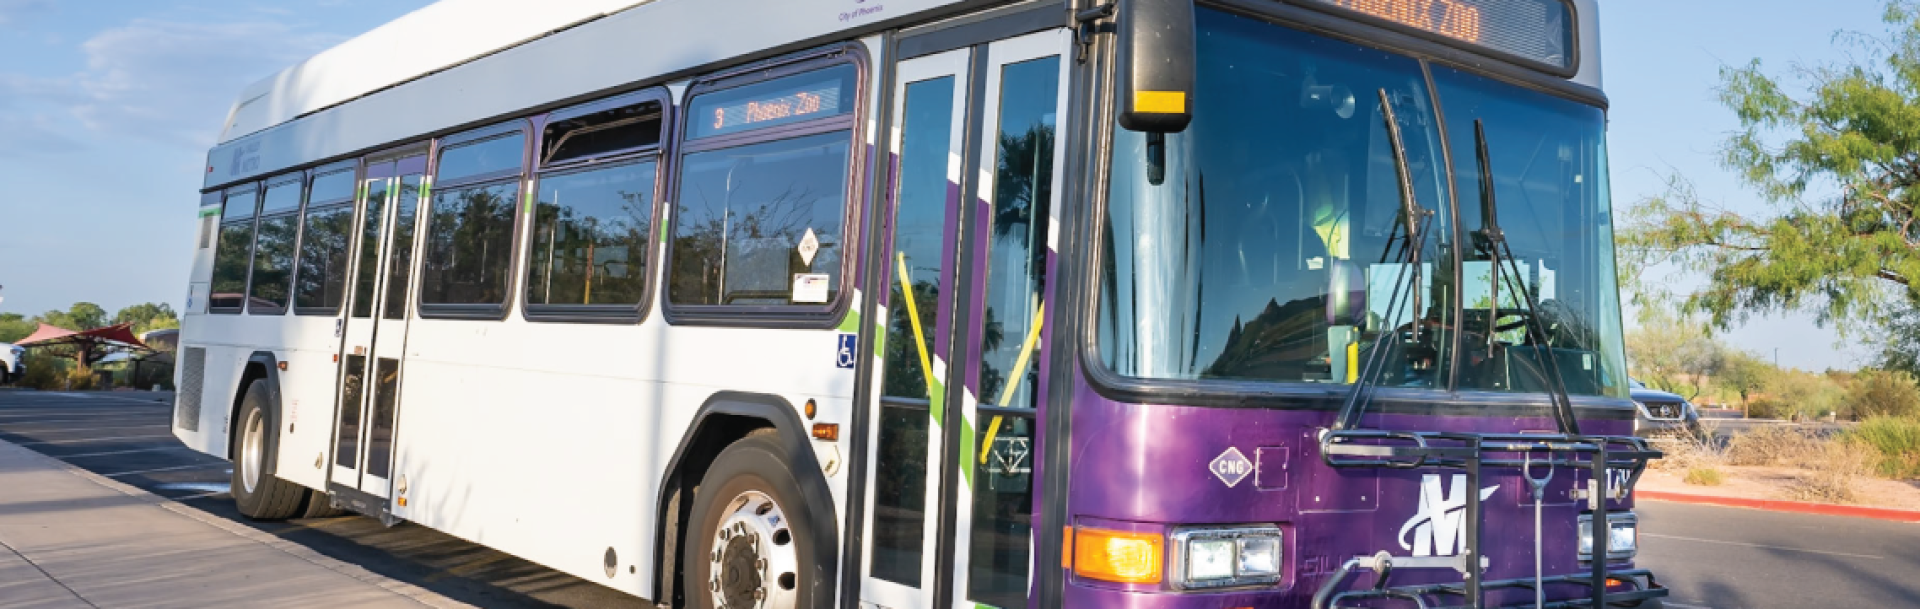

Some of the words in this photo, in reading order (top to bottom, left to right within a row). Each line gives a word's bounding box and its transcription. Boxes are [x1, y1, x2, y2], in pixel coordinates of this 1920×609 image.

[1336, 0, 1432, 31] ENIX
[714, 107, 725, 129] 3
[1219, 460, 1244, 475] CNG
